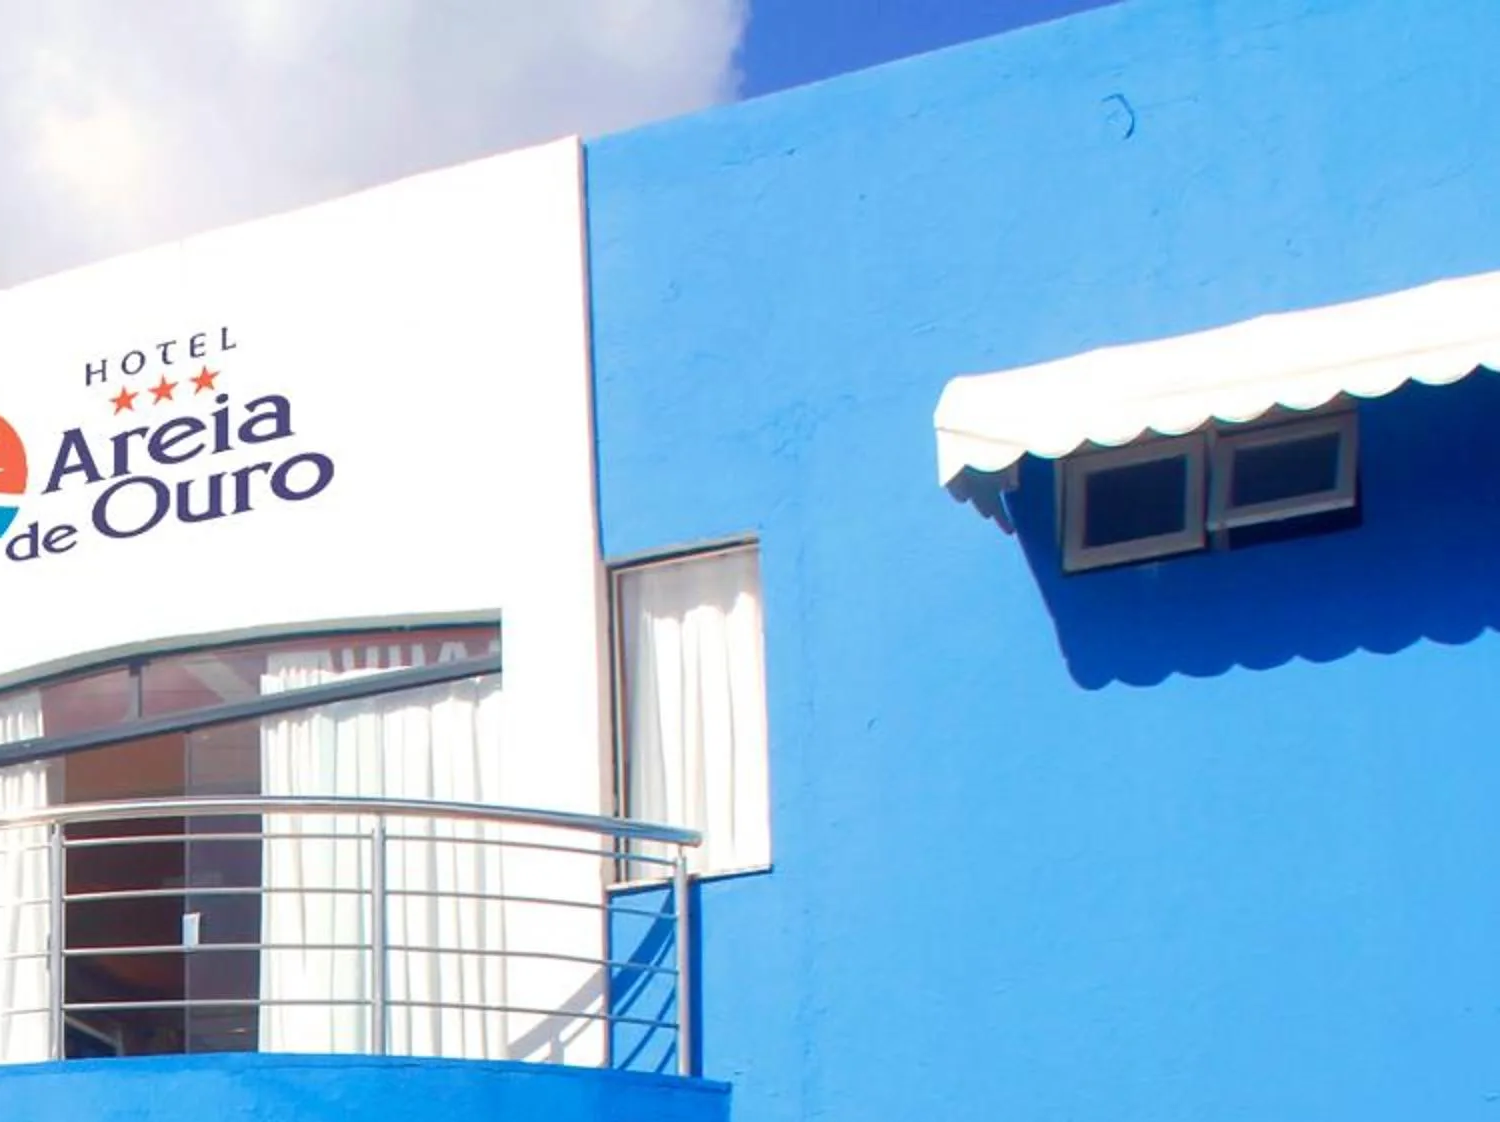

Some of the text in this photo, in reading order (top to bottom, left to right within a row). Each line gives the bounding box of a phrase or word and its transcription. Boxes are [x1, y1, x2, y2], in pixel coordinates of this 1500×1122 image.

[85, 326, 237, 387] HOTEL
[41, 393, 295, 495] Areia
[5, 451, 336, 562] de Ouro
